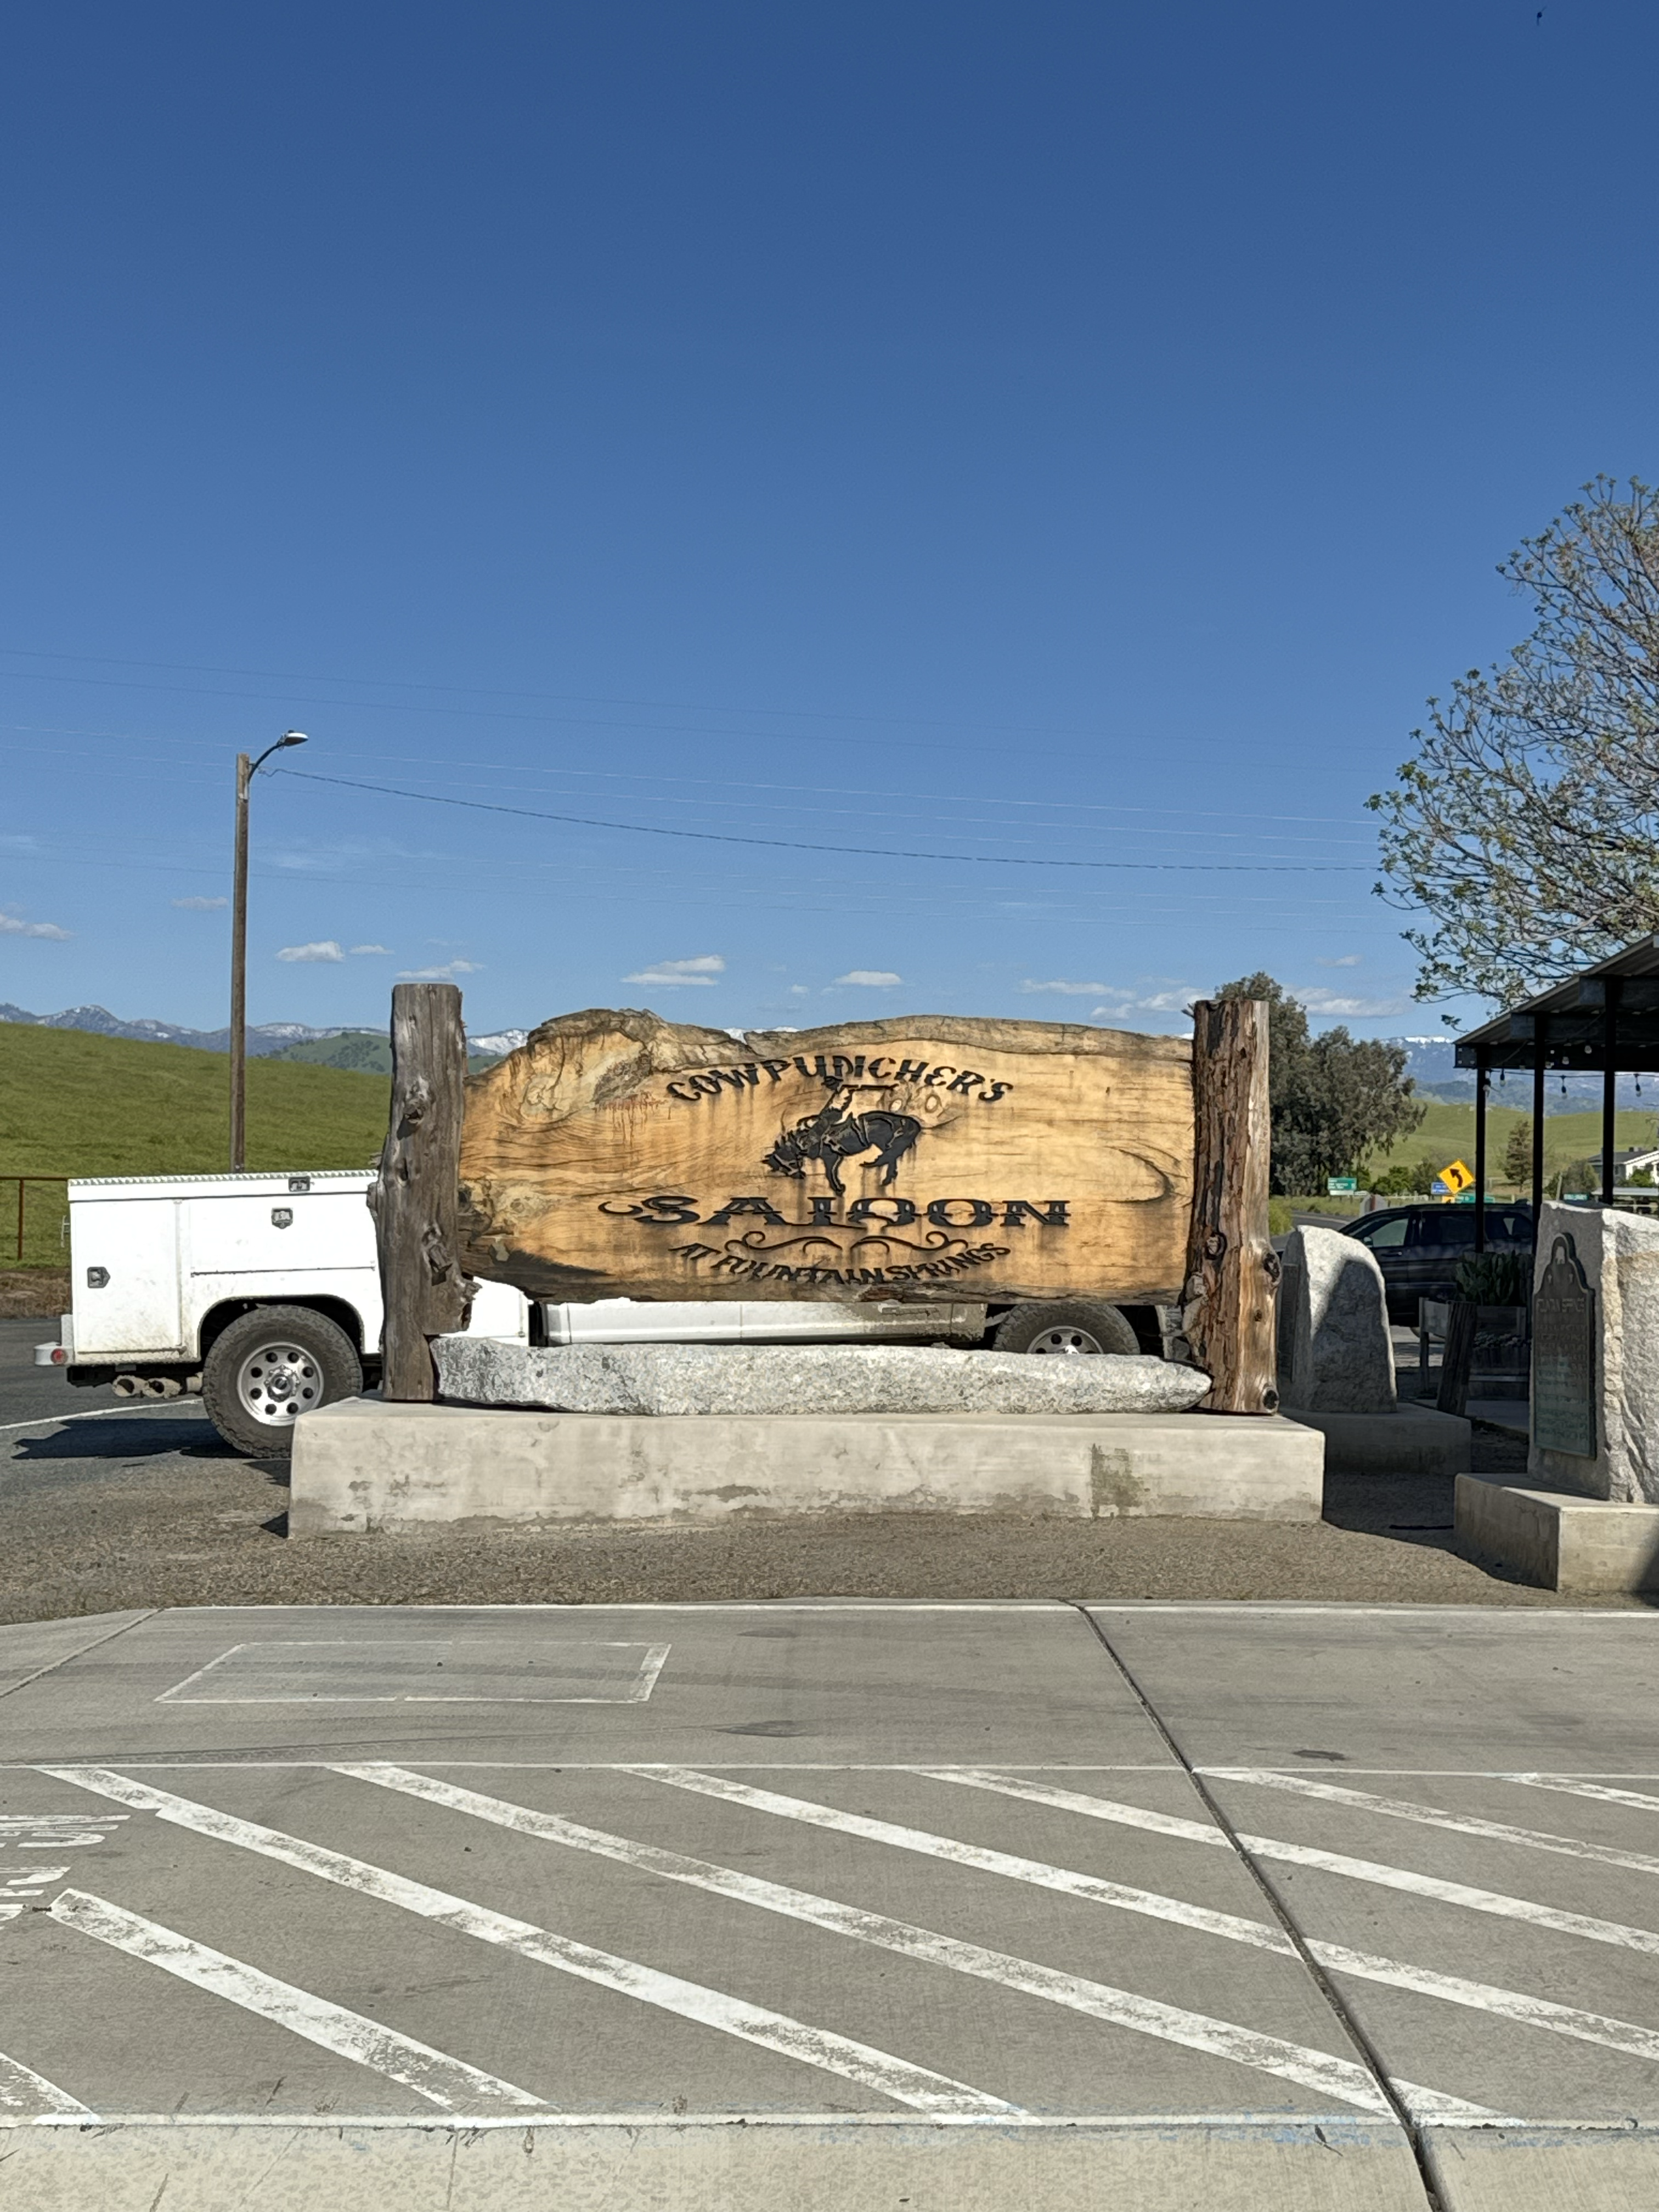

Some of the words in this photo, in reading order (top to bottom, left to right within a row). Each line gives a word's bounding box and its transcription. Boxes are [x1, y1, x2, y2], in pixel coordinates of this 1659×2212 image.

[599, 1196, 1071, 1229] SALOON
[668, 1243, 722, 1260] AT
[710, 1255, 885, 1285] FOUNTAIN
[885, 1243, 1011, 1280] SPRINGS
